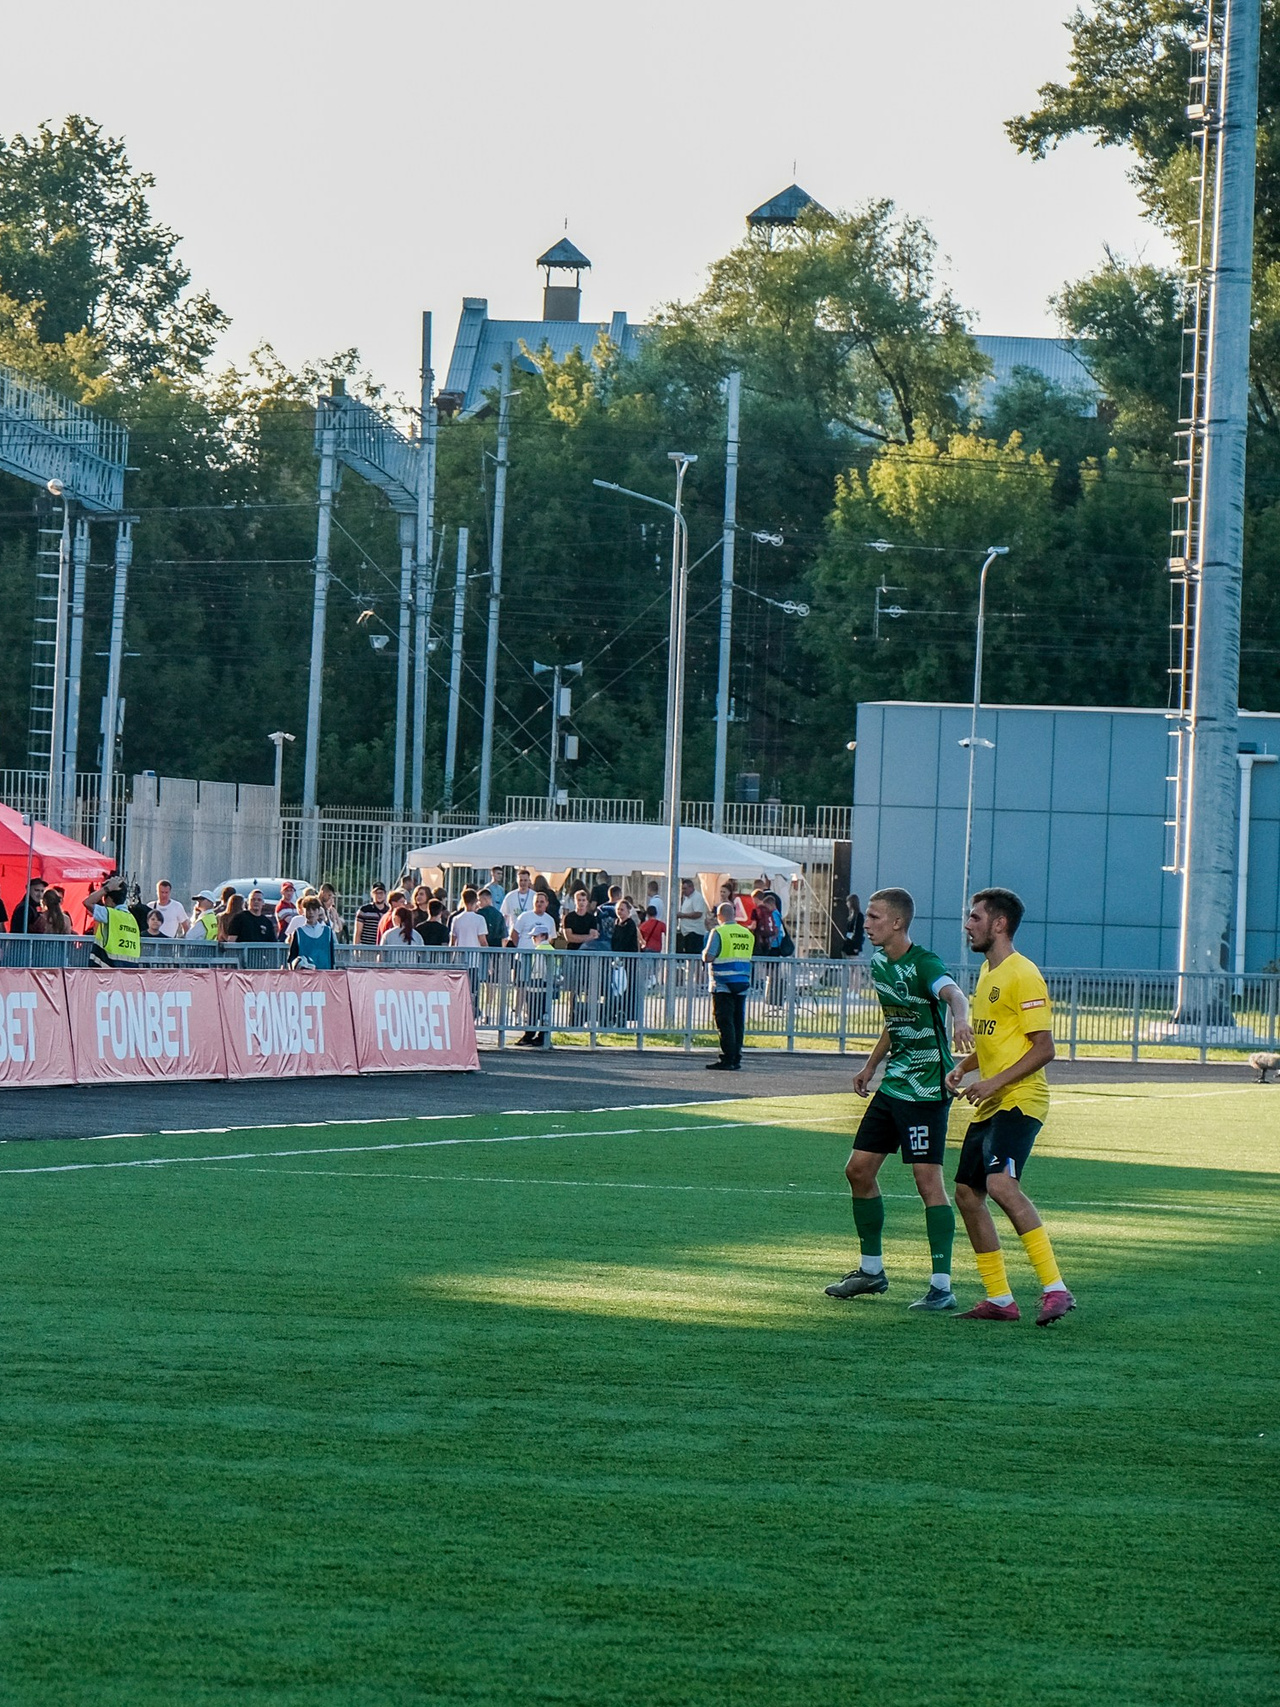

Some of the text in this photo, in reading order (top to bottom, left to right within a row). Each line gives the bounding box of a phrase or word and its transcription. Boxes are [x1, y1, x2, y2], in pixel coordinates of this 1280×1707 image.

[732, 942, 750, 951] 2092
[95, 990, 192, 1060] FONBET
[244, 990, 326, 1056] FONBET
[374, 988, 451, 1051] FONBET
[909, 1125, 929, 1150] 22
